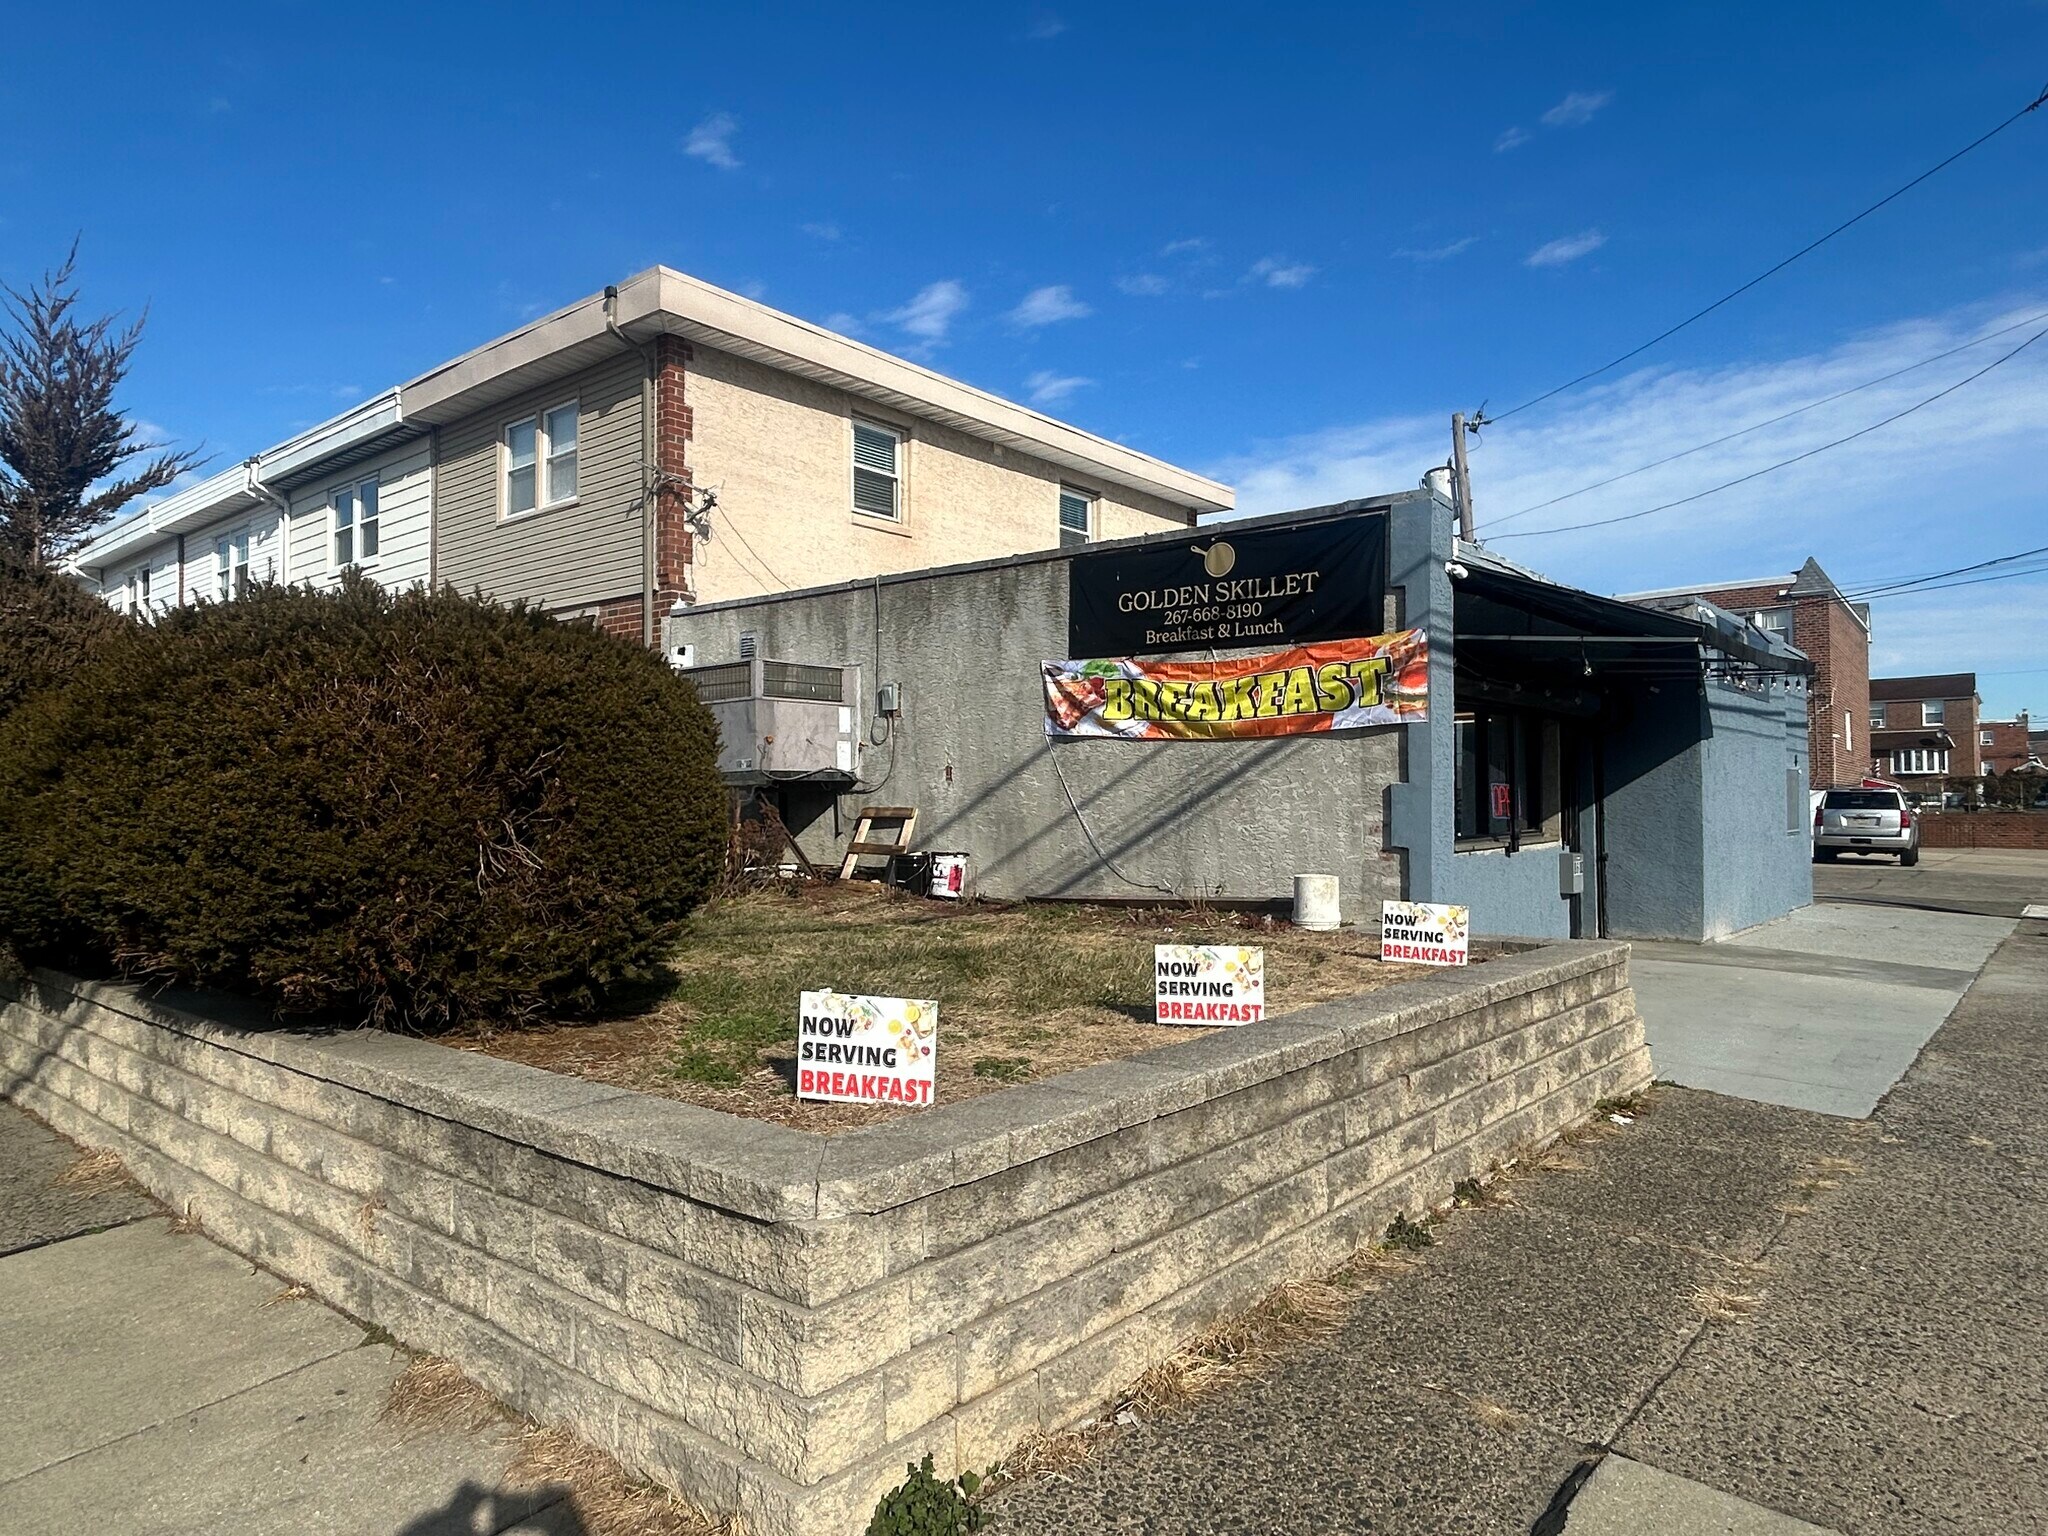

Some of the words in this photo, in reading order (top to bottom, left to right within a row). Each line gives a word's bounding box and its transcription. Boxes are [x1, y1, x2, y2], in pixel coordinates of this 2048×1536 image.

[1118, 584, 1210, 612] GOLDEN
[1215, 571, 1320, 602] SKILLET
[1164, 602, 1262, 625] 267-668-8190
[1146, 626, 1215, 644] Breakfast
[1217, 623, 1231, 638] &
[1235, 618, 1284, 637] Lunch
[1102, 656, 1394, 722] BREAKFAST
[1384, 913, 1418, 926] NOW
[1383, 928, 1444, 943] SERVING
[1383, 944, 1466, 963] BREAKFAST
[1157, 962, 1200, 977] NOW
[1158, 981, 1234, 997] SERVING
[1158, 1001, 1262, 1023] BREAKFAST
[802, 1015, 855, 1038] NOW
[801, 1041, 897, 1068] SERVING
[800, 1069, 932, 1103] BREAKFAST
